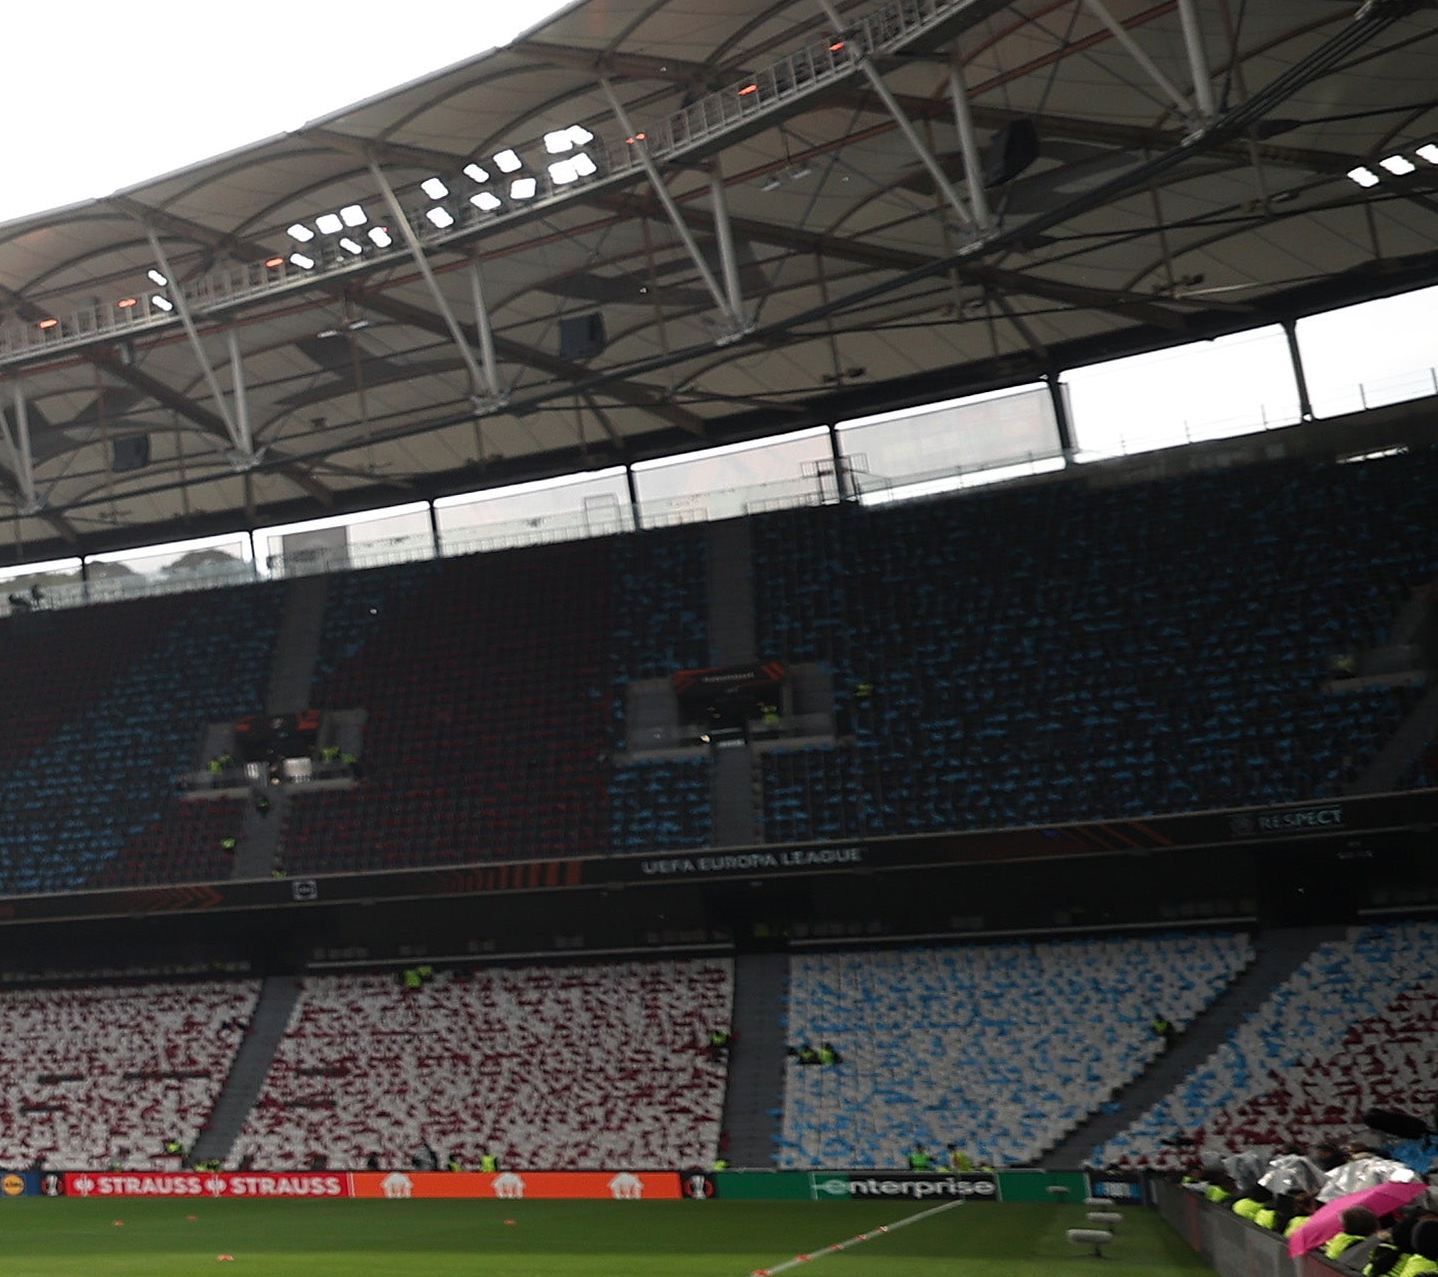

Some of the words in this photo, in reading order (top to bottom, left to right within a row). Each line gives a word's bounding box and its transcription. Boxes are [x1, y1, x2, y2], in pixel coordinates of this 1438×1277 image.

[1256, 808, 1343, 831] RESPECT
[641, 858, 695, 874] UEFA
[697, 853, 778, 872] EUROPA
[781, 848, 862, 867] LEAGUE
[95, 1175, 204, 1195] STRAUSS
[228, 1175, 342, 1195] STRAUSS
[813, 1176, 995, 1197] enterprise
